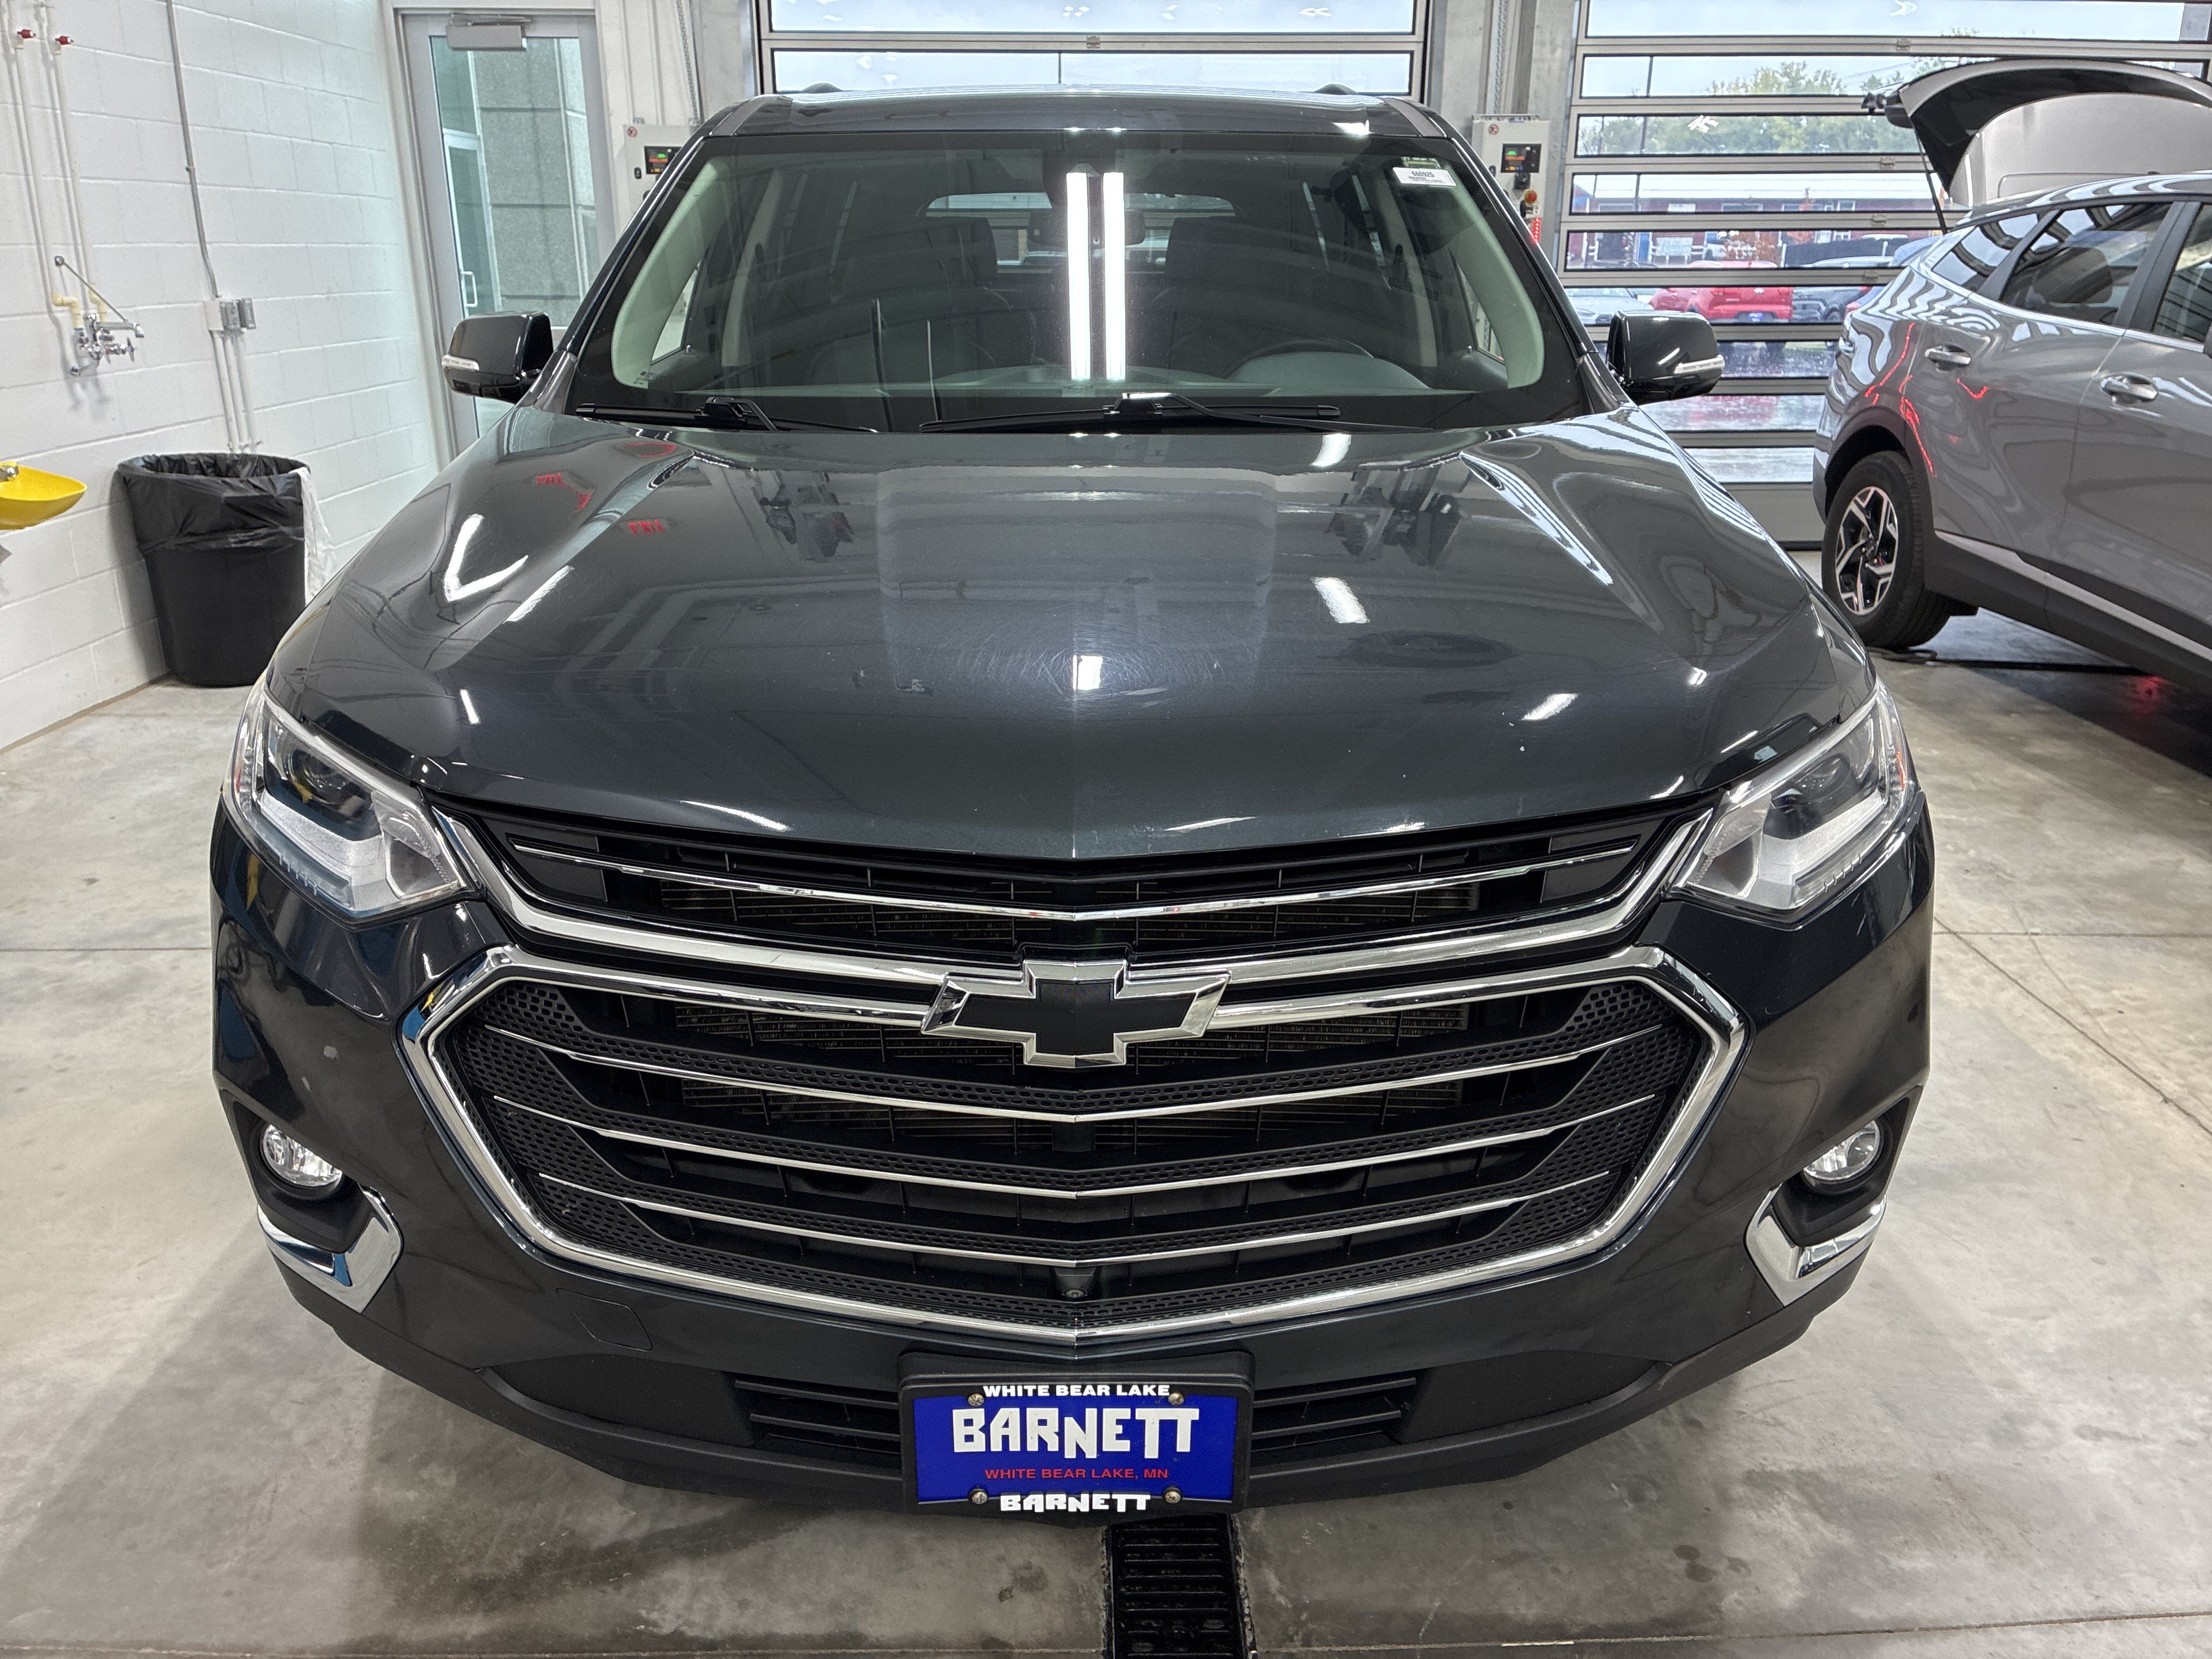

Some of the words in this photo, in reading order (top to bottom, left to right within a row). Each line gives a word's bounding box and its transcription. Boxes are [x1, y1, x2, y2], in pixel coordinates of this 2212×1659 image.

[983, 1385, 1050, 1397] WHITE
[1056, 1384, 1110, 1397] BEAR
[1116, 1384, 1170, 1397] LAKE
[952, 1407, 1200, 1459] BARNETT
[985, 1468, 1036, 1479] WHITE
[1041, 1468, 1086, 1479] BEAR
[1091, 1468, 1138, 1480] LAKE,
[1144, 1468, 1169, 1478] MN
[1000, 1493, 1151, 1513] BARNETT
